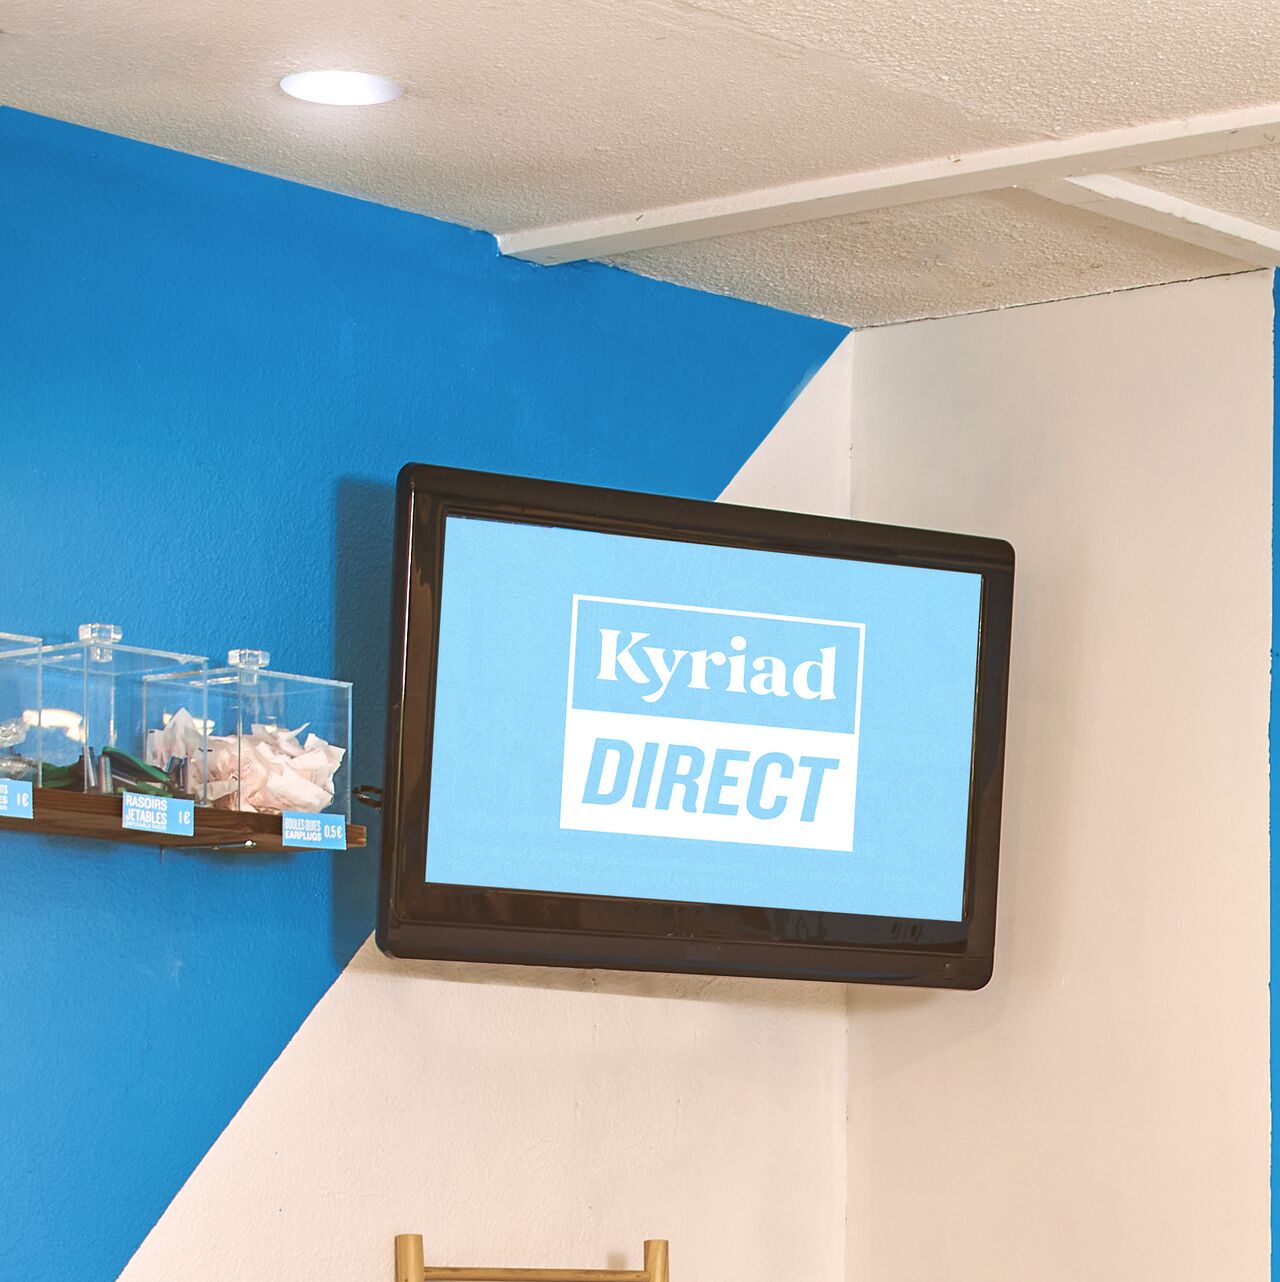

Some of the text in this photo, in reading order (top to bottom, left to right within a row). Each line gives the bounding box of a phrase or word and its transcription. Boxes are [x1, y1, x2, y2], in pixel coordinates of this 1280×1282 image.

[596, 628, 837, 703] Kyriad
[581, 737, 840, 822] DIRECT
[126, 794, 168, 811] RASOIRS
[126, 808, 168, 825] JETABLES
[285, 830, 322, 842] EARPLUGS
